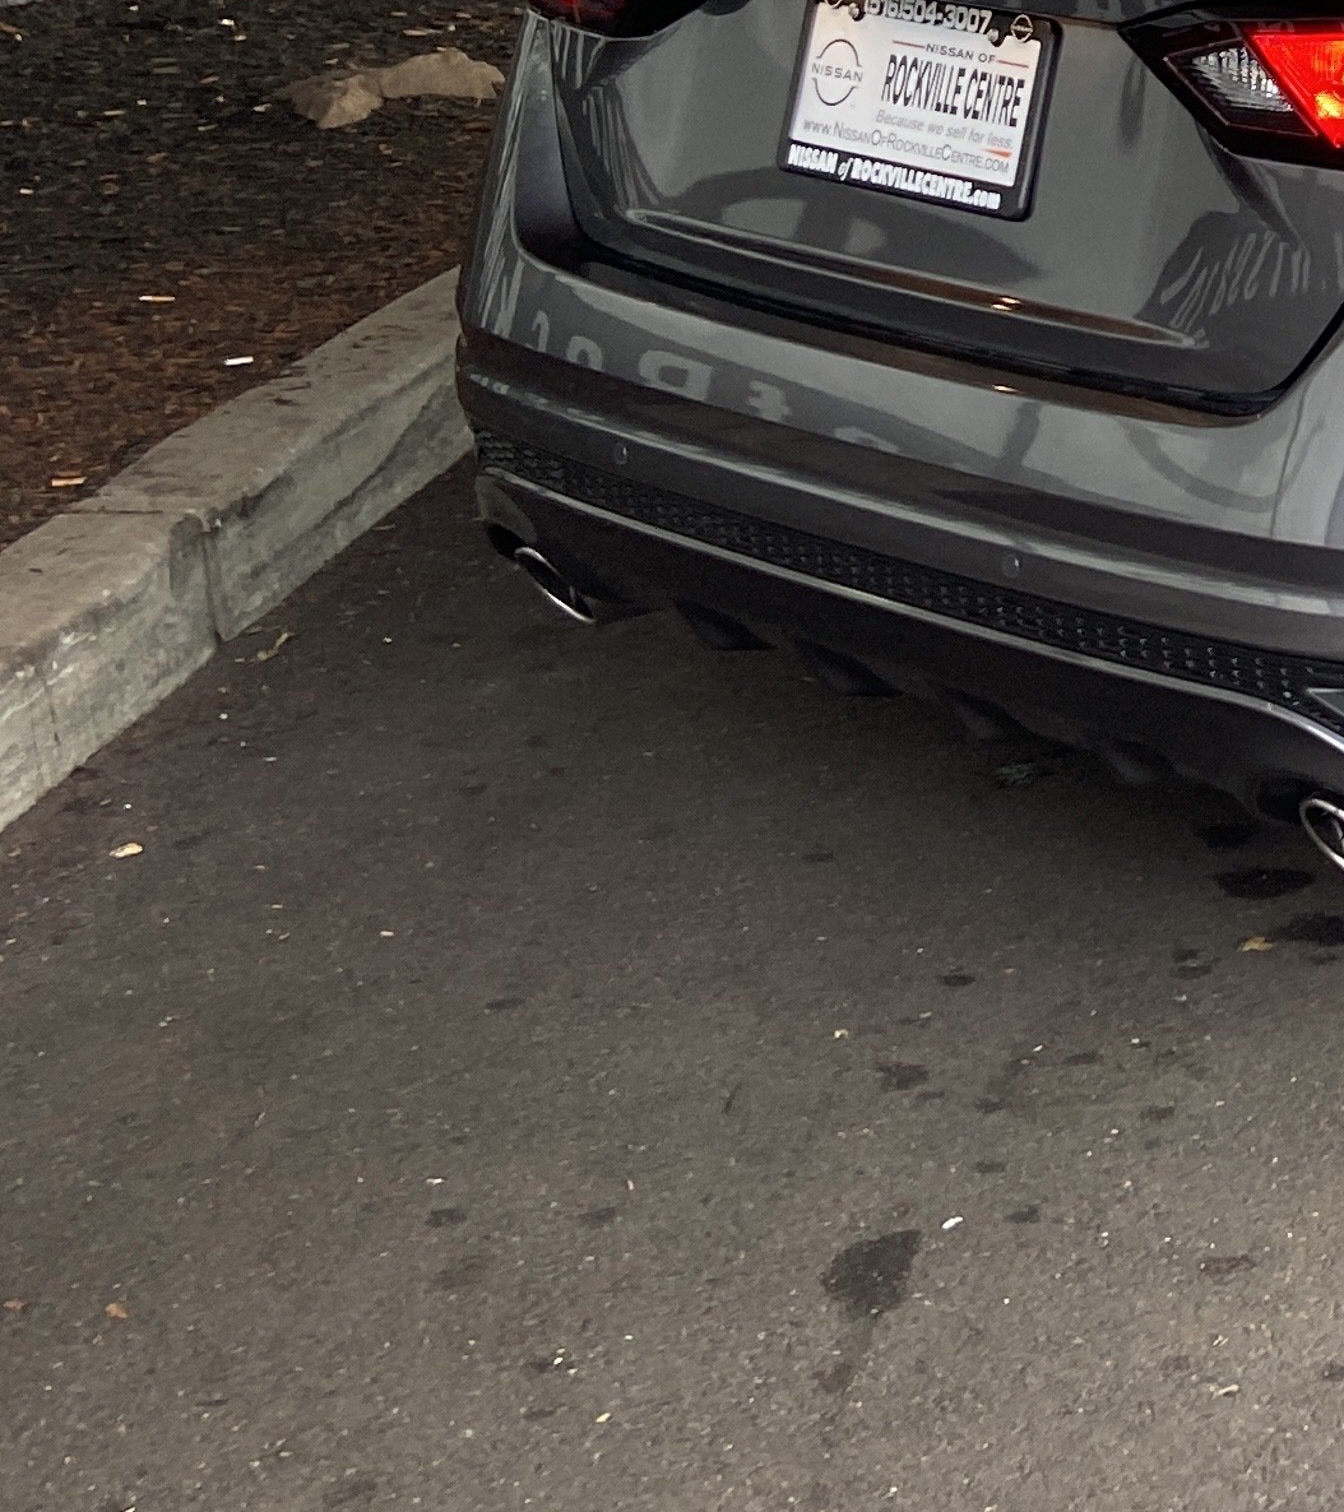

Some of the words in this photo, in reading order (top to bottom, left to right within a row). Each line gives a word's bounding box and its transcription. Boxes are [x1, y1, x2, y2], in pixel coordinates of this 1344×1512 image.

[925, 43, 974, 60] NISSAN
[978, 53, 996, 64] OF
[811, 63, 863, 82] NISSAN
[881, 54, 964, 115] ROCKVILLE
[962, 69, 1024, 127] CENTRE
[876, 109, 925, 131] Because
[928, 123, 944, 135] we
[947, 126, 968, 139] sell
[968, 129, 986, 144] for
[787, 143, 839, 175] NISSAN
[838, 157, 853, 181] of
